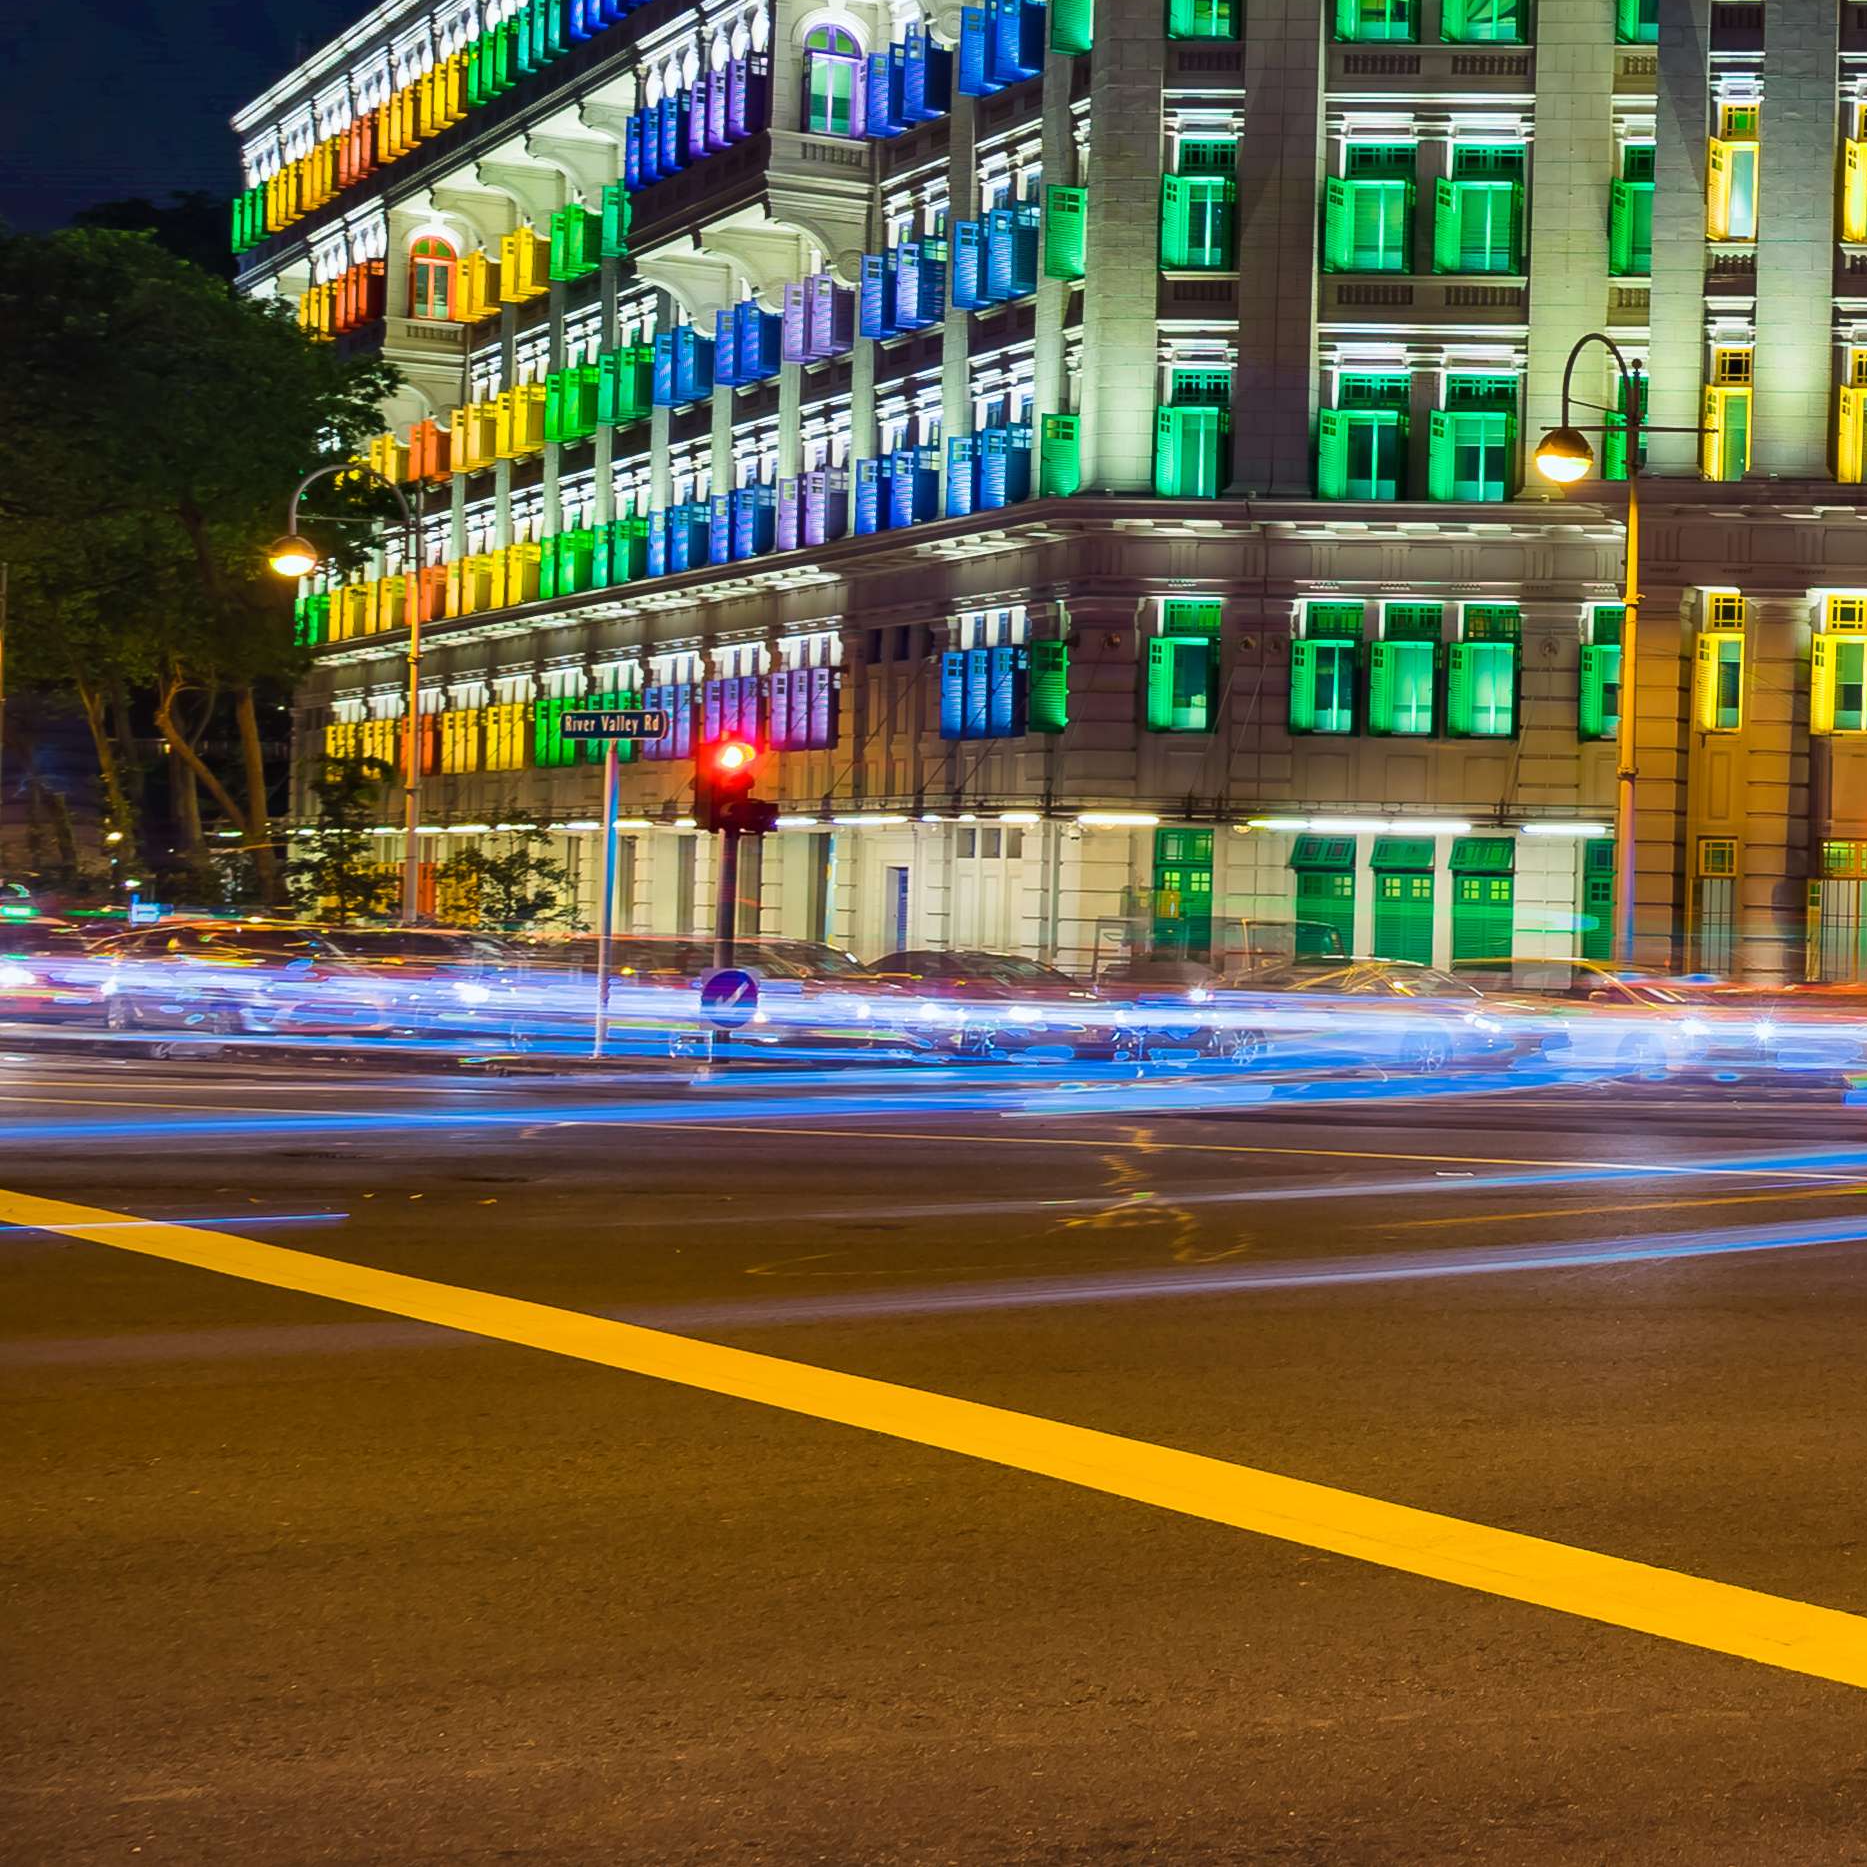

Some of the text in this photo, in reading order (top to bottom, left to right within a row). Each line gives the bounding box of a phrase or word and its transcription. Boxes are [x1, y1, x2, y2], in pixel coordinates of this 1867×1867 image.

[564, 714, 660, 735] River Valley Rd
